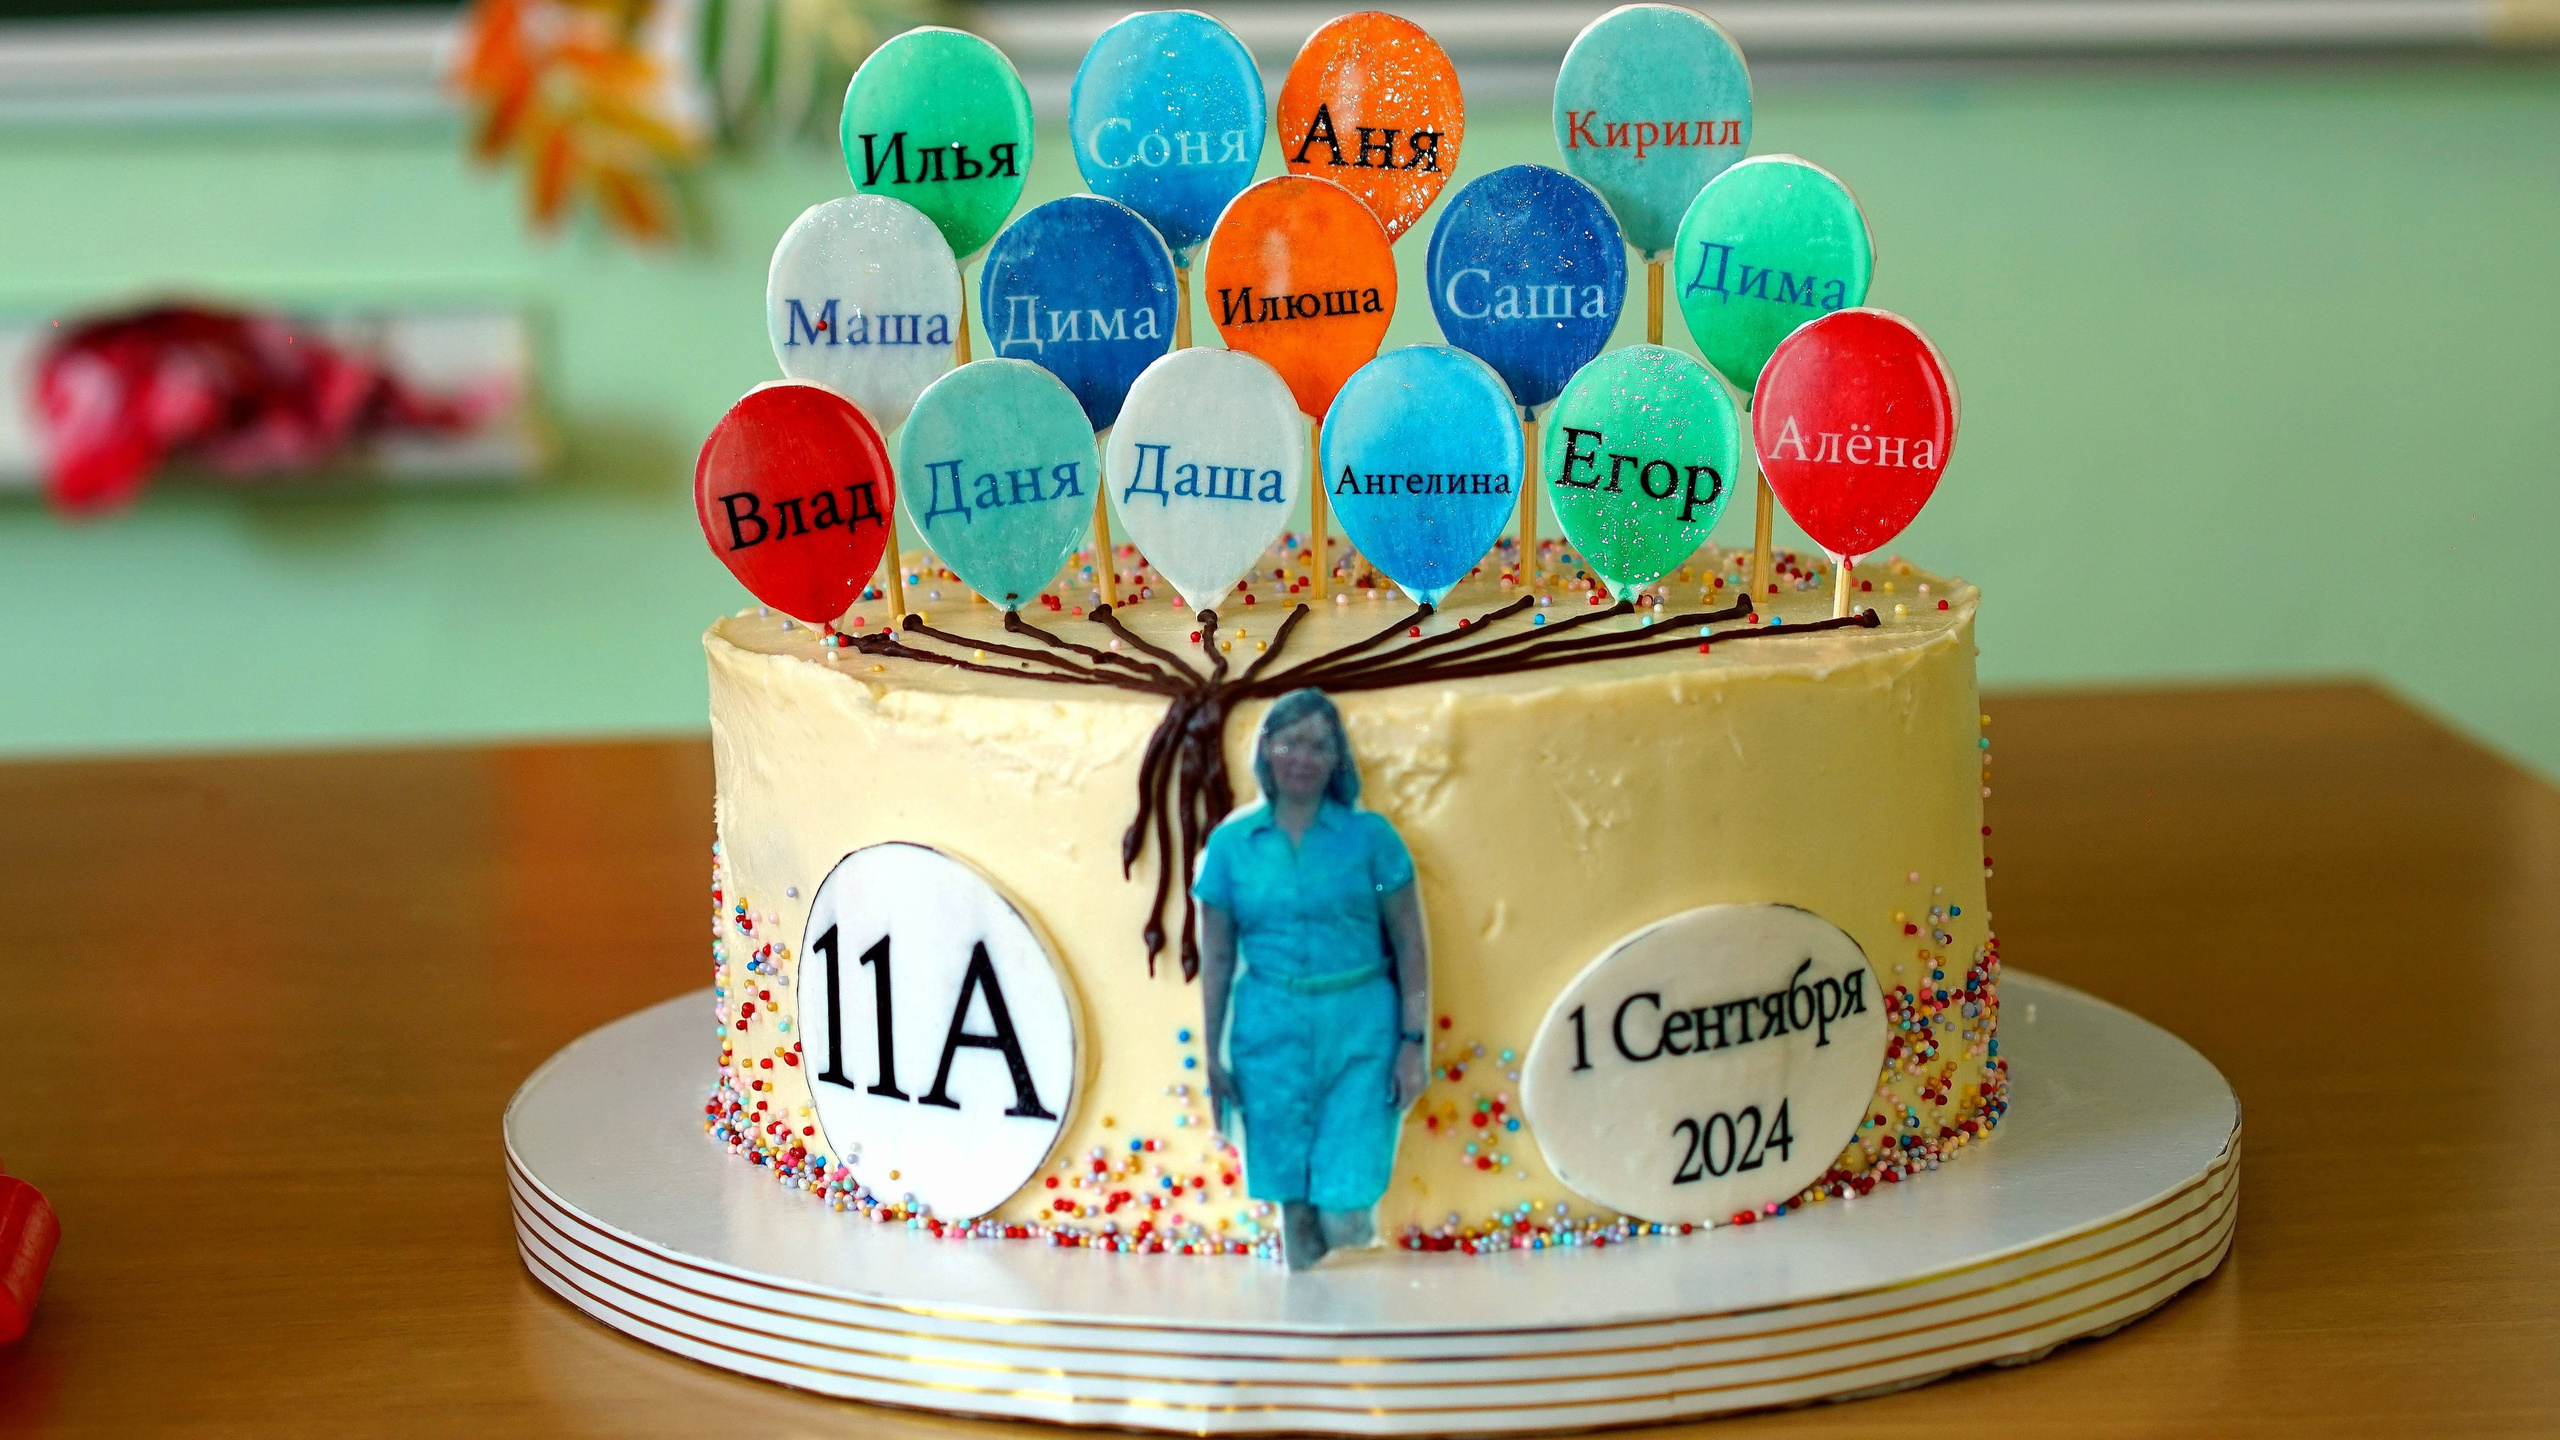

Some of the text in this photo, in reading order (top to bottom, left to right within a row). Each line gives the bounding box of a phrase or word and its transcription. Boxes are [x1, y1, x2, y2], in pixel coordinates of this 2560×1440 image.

[858, 132, 1020, 187] Илья
[1088, 117, 1252, 170] Соня
[1290, 102, 1445, 172] Аня
[1565, 109, 1742, 160] Кирилл
[1220, 284, 1384, 327] Илюша
[1446, 268, 1607, 320] Саша
[1686, 240, 1848, 311] Дима
[783, 299, 954, 347] Маша
[1000, 296, 1162, 357] Дима
[1766, 415, 1939, 470] Алёна
[924, 459, 1085, 529] Даня
[1124, 443, 1286, 506] Даша
[1333, 464, 1512, 497] Ангелина
[1555, 426, 1722, 522] Егор
[718, 480, 882, 551] Влад
[1568, 957, 1867, 1072] 1 Сентября
[1672, 1096, 1793, 1185] 2024
